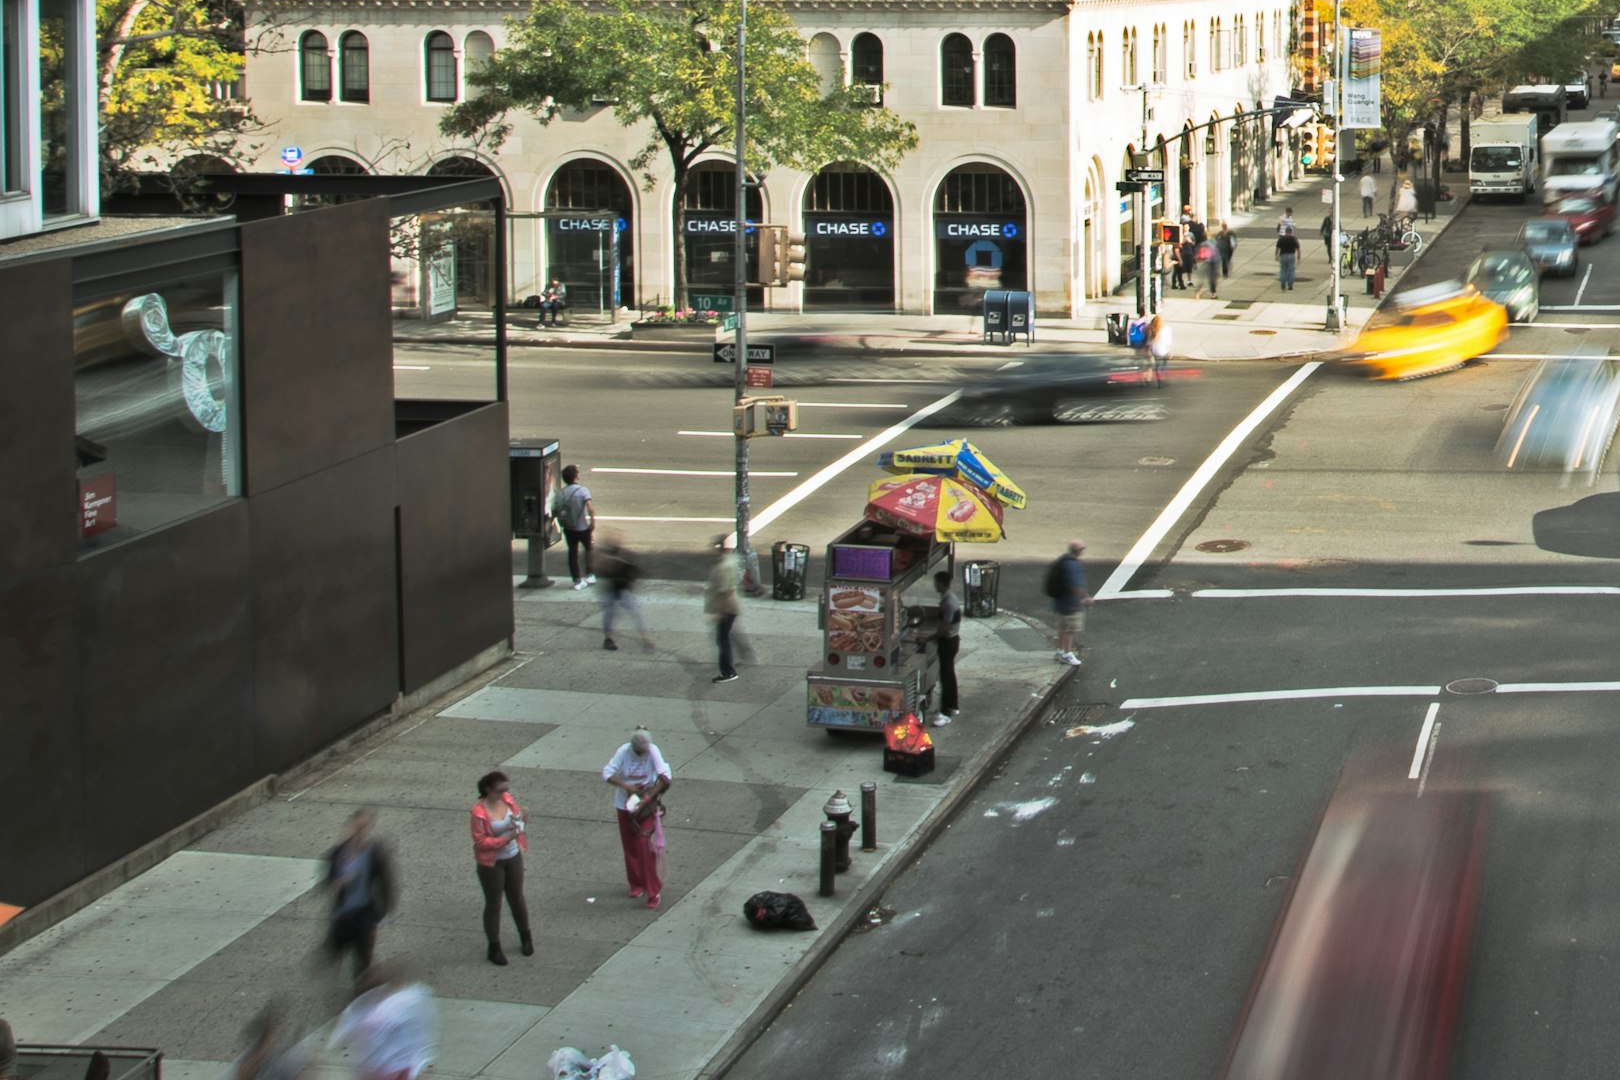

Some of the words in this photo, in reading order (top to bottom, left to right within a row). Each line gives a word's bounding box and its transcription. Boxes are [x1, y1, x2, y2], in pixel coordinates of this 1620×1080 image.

[1350, 116, 1372, 124] PACE
[559, 219, 610, 230] CHASE
[687, 220, 737, 232] CHASE
[816, 222, 869, 235] CHASE
[947, 224, 1000, 236] CHASE
[697, 297, 711, 310] 10
[722, 349, 735, 357] ON
[748, 349, 767, 358] WAY
[896, 453, 954, 465] SABRETT
[84, 491, 96, 501] Jim
[84, 510, 97, 519] Fine
[85, 518, 96, 528] Art
